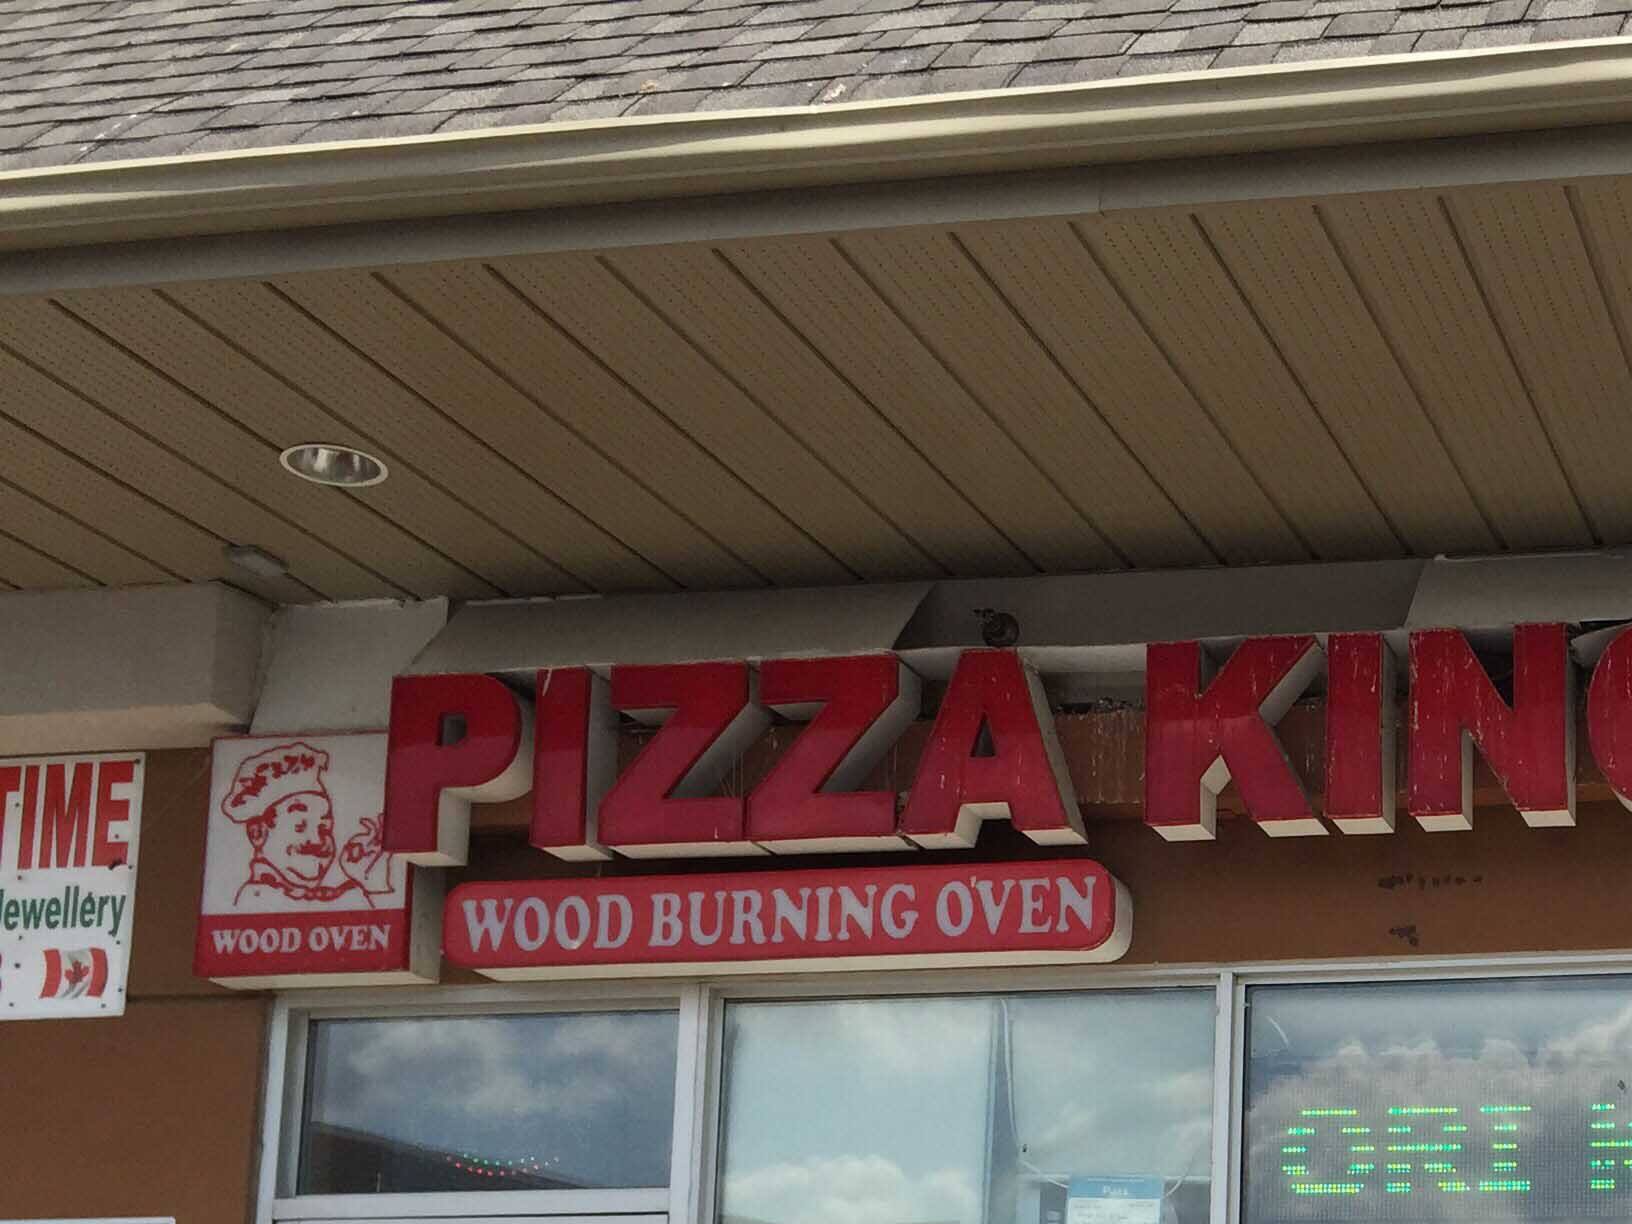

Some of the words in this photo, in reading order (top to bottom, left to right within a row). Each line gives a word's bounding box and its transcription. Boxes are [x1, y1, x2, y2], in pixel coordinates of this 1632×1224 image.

[383, 647, 1085, 860] PIZZA
[211, 927, 301, 954] WOOD
[308, 924, 391, 951] OVEN
[461, 894, 633, 952] WOOD
[649, 883, 918, 948] BURNING
[936, 875, 1096, 936] OVEN
